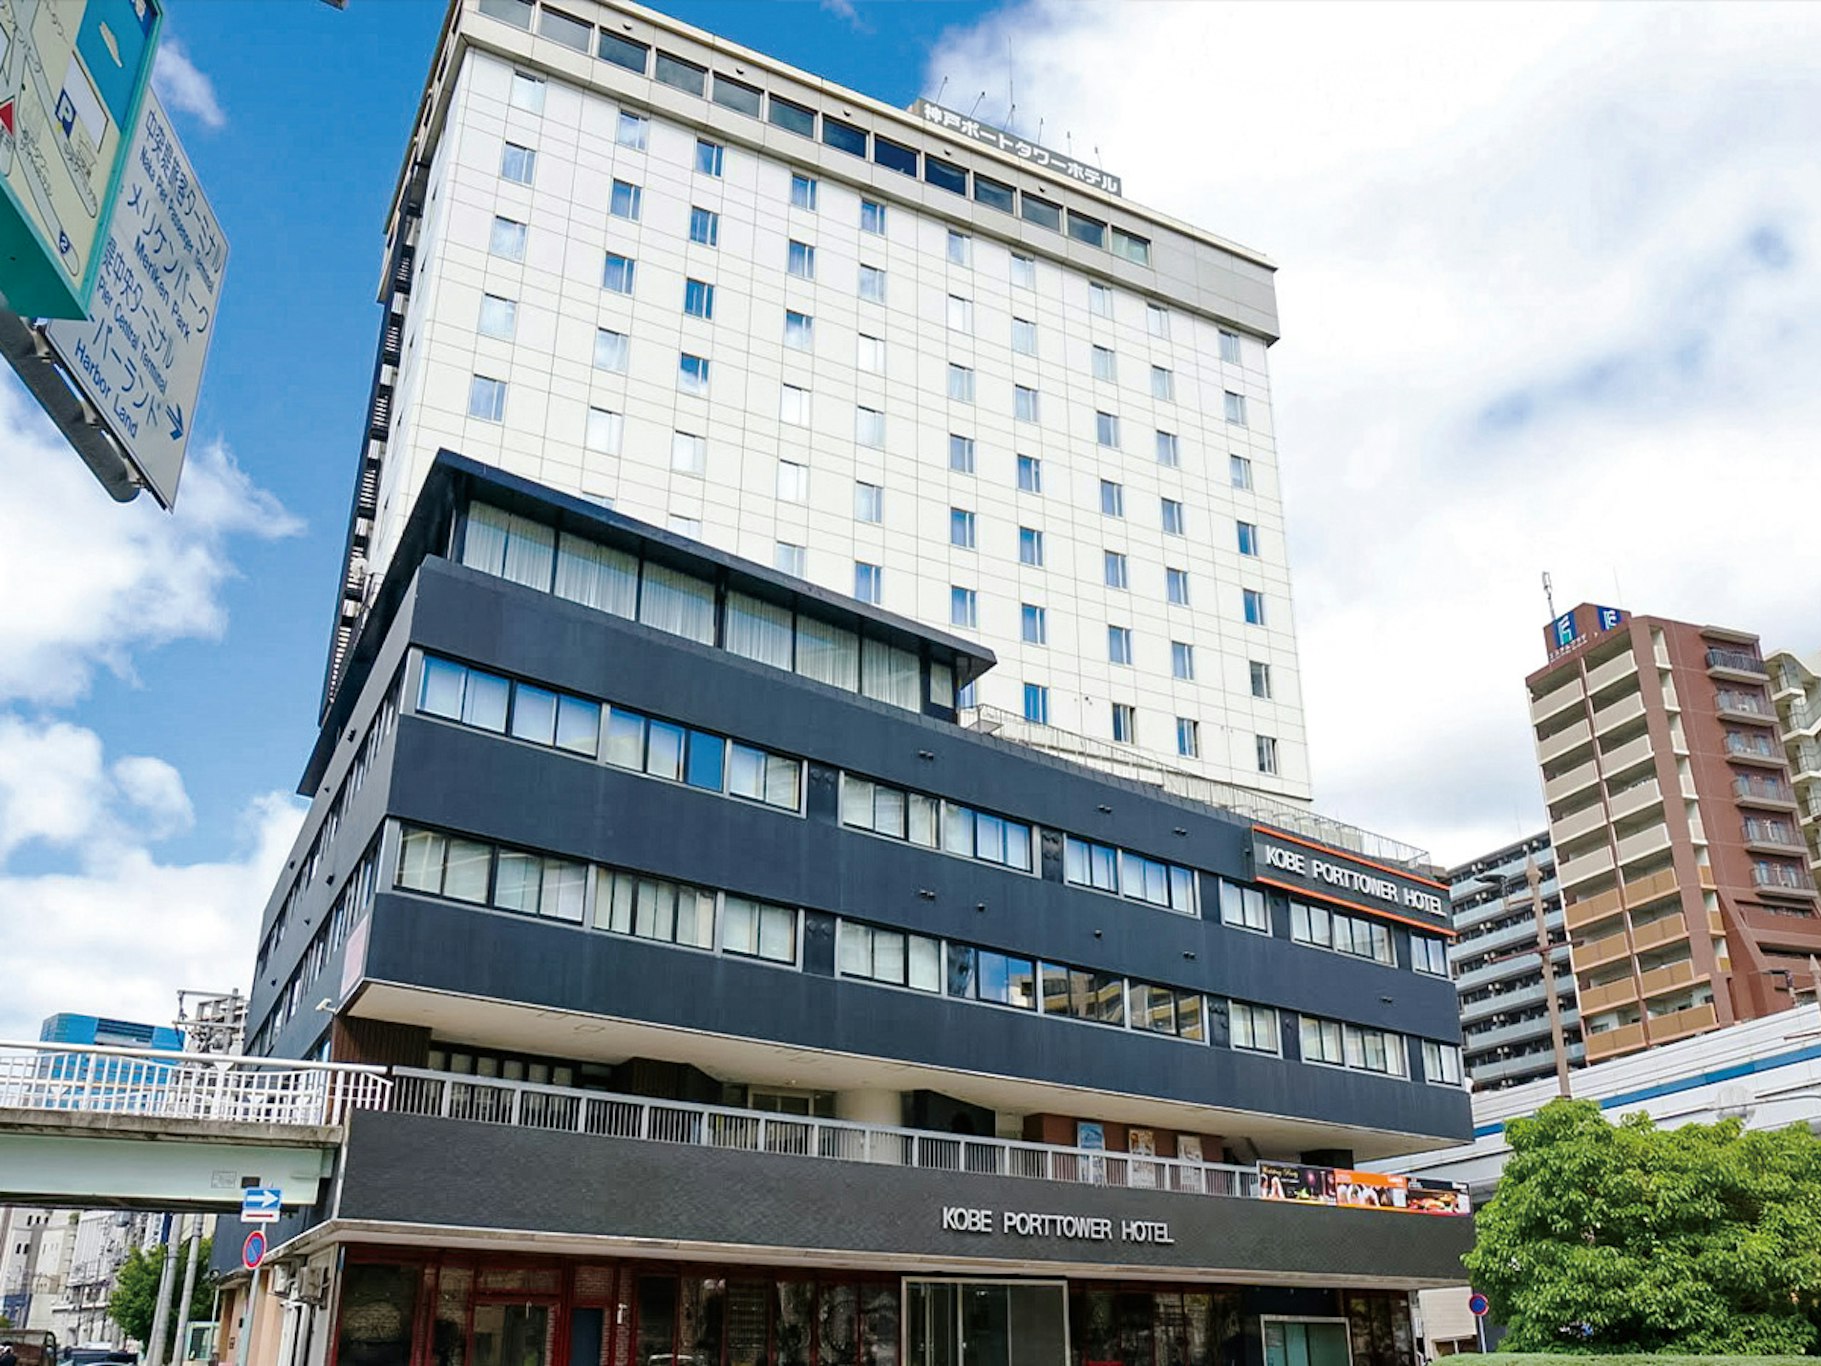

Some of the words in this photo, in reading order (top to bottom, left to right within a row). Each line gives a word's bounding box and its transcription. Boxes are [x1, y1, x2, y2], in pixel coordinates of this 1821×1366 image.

[924, 103, 1118, 192] 神戸ポートタワーホテル
[127, 184, 208, 333] メリケンパーク
[134, 235, 169, 306] Meriken
[171, 301, 190, 344] Park
[97, 275, 113, 307] Pier
[114, 302, 140, 351] Central
[139, 342, 168, 396] Terminal
[74, 338, 111, 398] Harbor
[113, 394, 139, 439] Land
[1265, 845, 1305, 875] KOBE
[1312, 859, 1399, 903] PORTTOWER
[1403, 887, 1447, 917] HOTEL
[942, 1206, 992, 1233] KOBE
[1003, 1212, 1113, 1240] PORTTOWER
[1121, 1220, 1175, 1244] HOTEL
